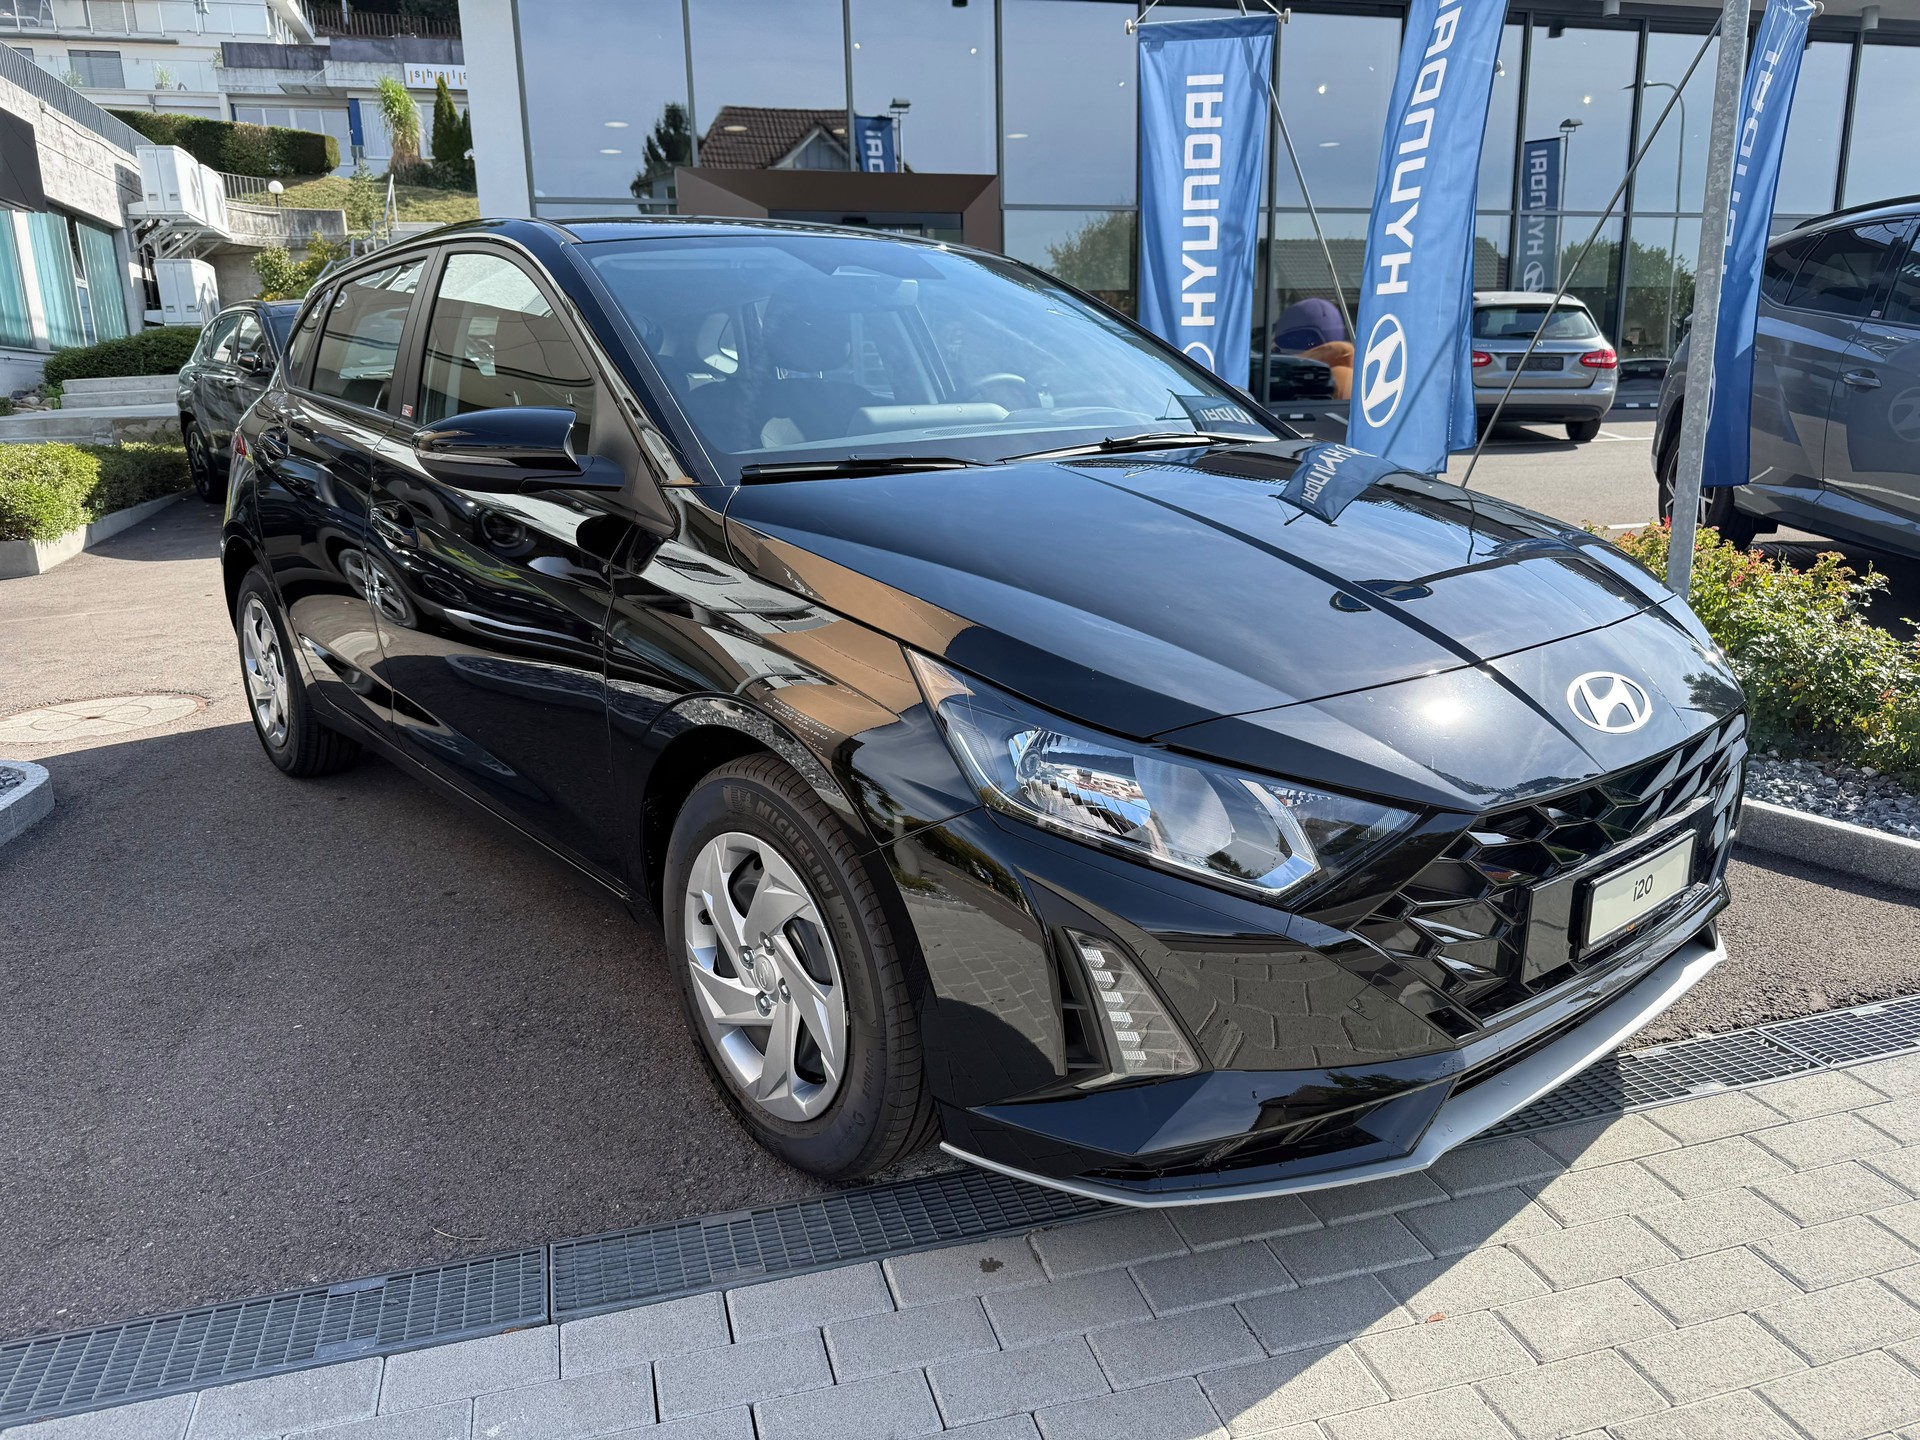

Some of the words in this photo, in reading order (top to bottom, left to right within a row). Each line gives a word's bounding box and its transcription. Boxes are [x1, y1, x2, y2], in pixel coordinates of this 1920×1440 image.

[1181, 73, 1224, 327] HYUNDAI
[755, 800, 834, 893] MICHELIN
[1633, 874, 1654, 902] i20
